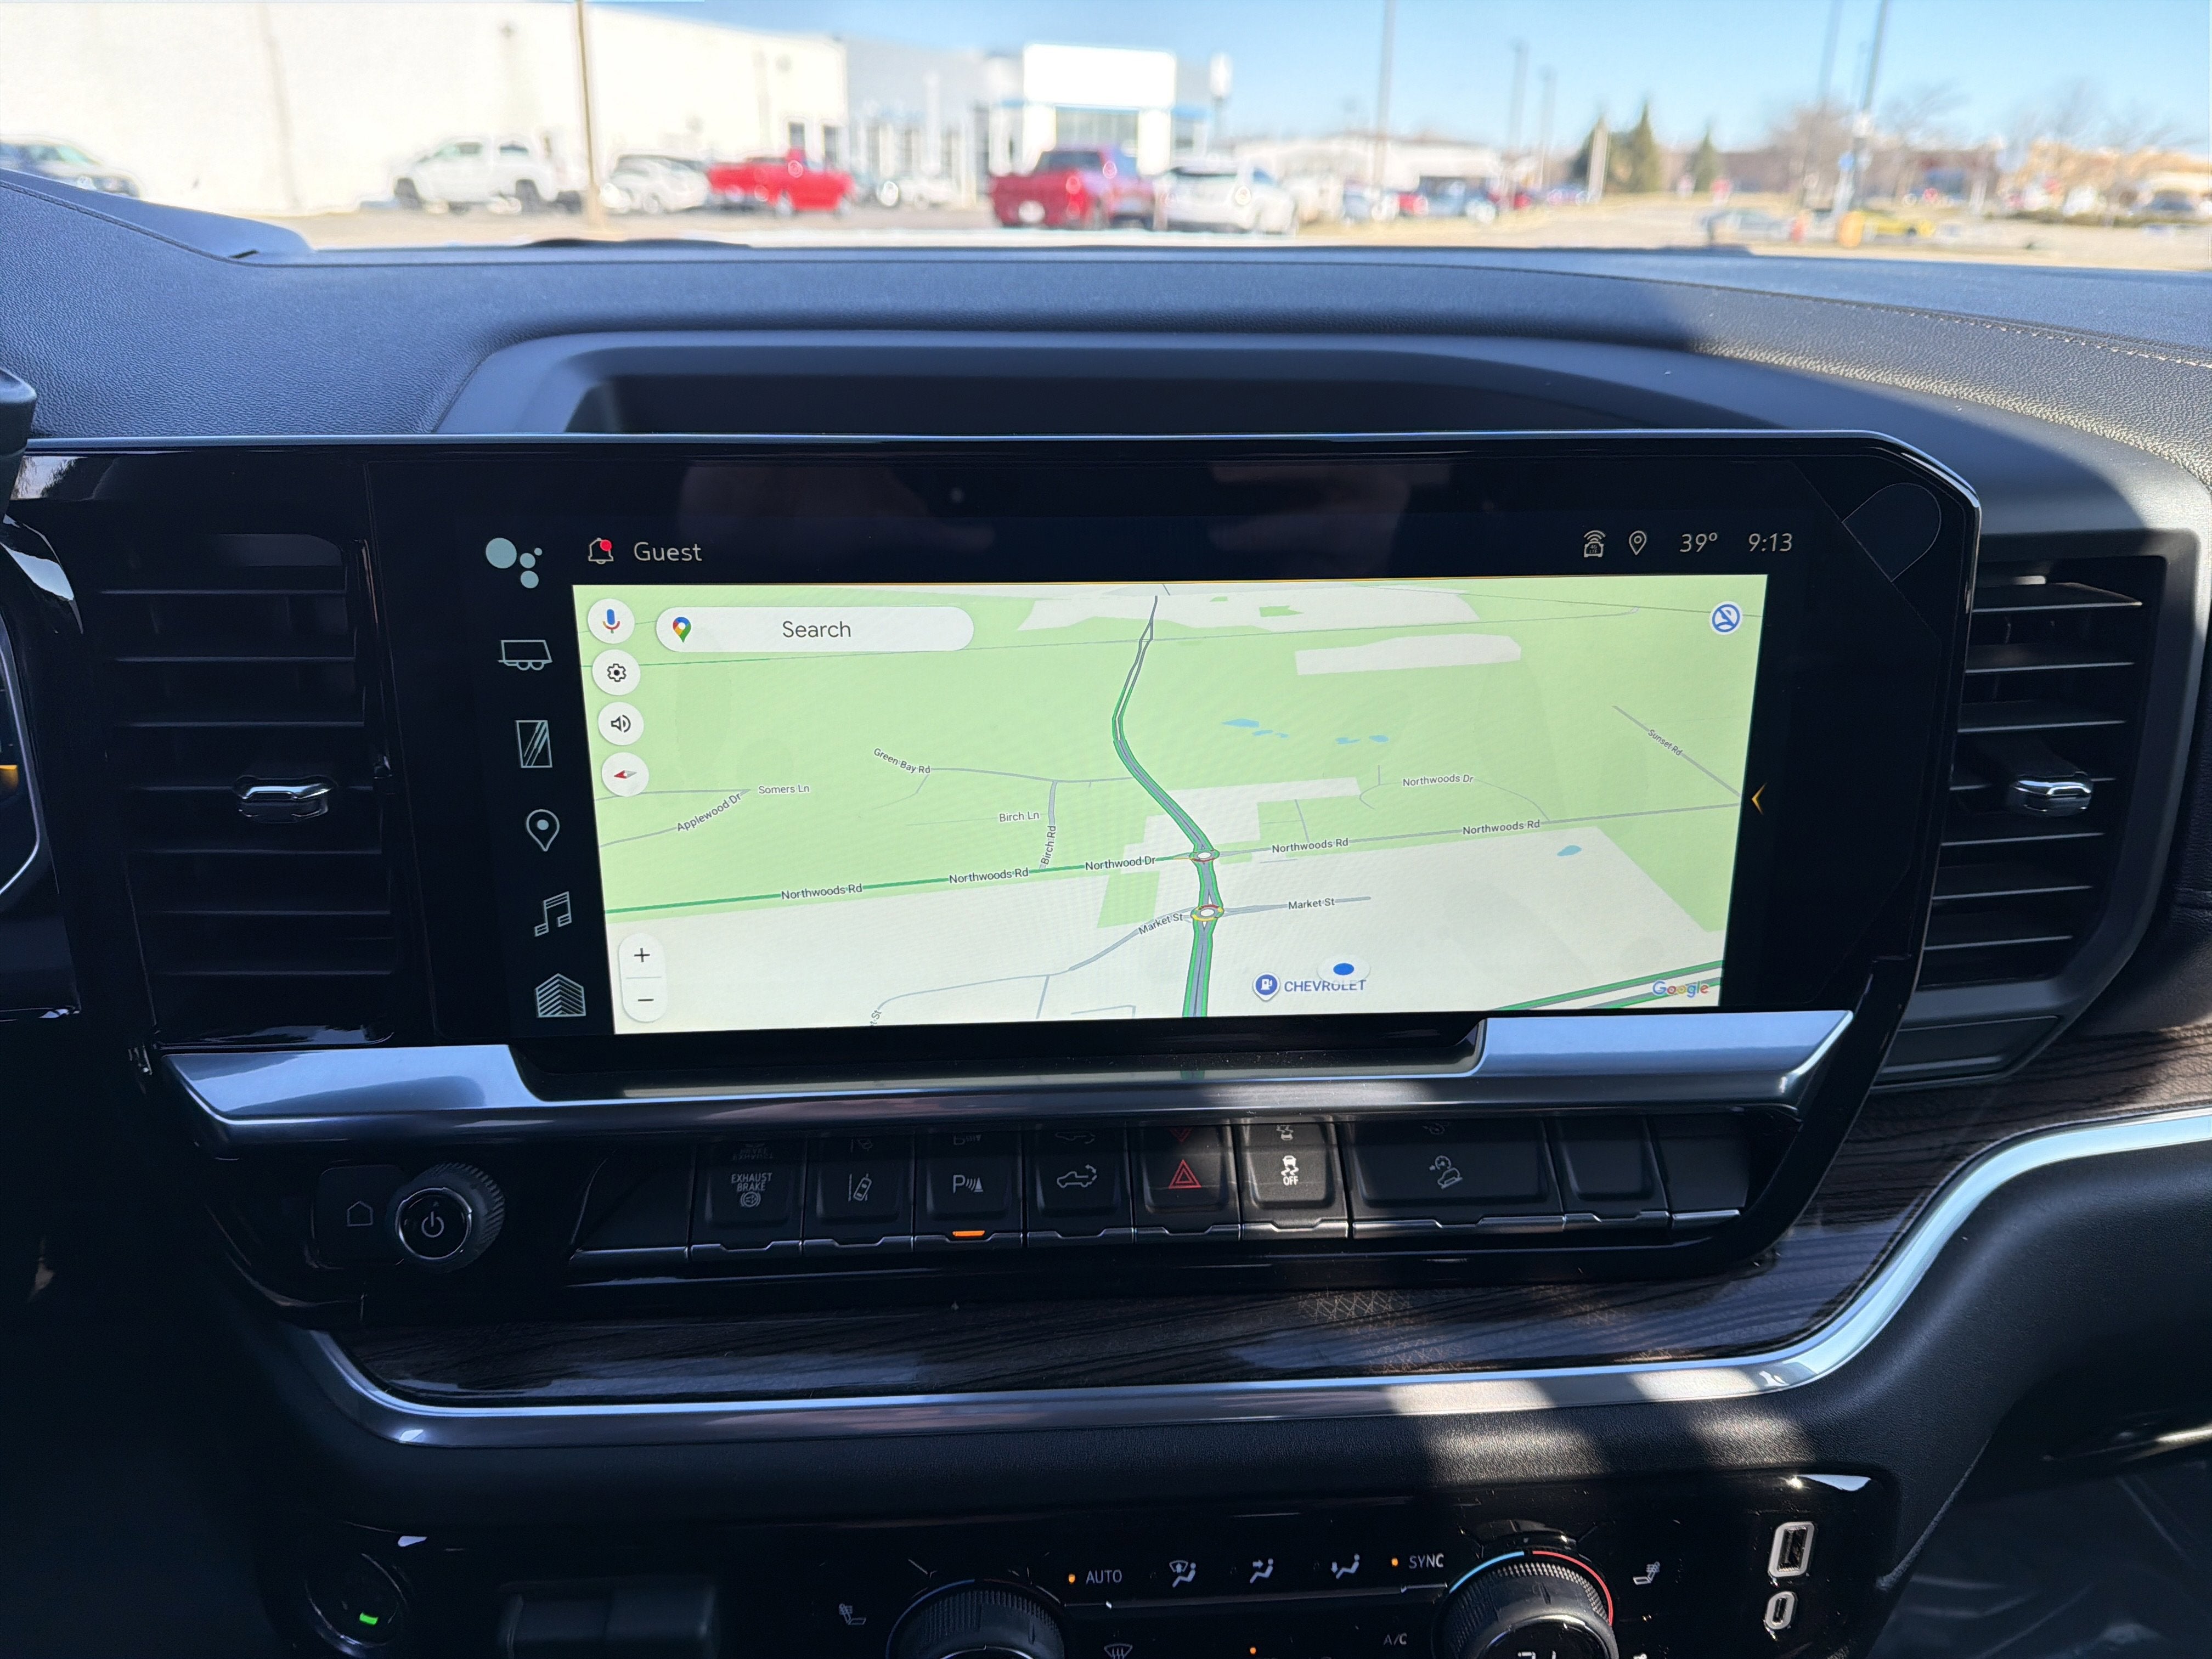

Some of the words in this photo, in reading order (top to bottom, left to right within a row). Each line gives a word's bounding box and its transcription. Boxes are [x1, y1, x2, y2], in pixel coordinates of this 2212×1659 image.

[1748, 533, 1793, 552] 9:13
[634, 541, 702, 562] Guest
[782, 621, 851, 639] Search
[1648, 729, 1672, 748] Sunset
[1672, 745, 1683, 756] Rd
[873, 748, 899, 764] Green
[899, 760, 917, 775] Bay
[918, 765, 931, 774] Rd
[758, 784, 795, 794] Somers
[798, 783, 810, 793] Ln
[1402, 774, 1461, 787] Northwoods
[1463, 774, 1474, 783] Dr
[676, 799, 731, 832] Applewood
[730, 792, 742, 805] Dr
[999, 812, 1024, 822] Birch
[1027, 811, 1040, 820] Ln
[1046, 825, 1057, 839] Rd
[1462, 822, 1525, 836] Northwoods
[1527, 820, 1541, 829] Rd
[1040, 840, 1054, 865] Birch
[1272, 839, 1333, 854] Northwoods
[1335, 838, 1348, 848] Rd
[1085, 858, 1143, 871] Northwood
[1144, 855, 1155, 865] Dr
[949, 870, 1012, 884] Northwoods
[1014, 867, 1029, 877] Rd
[781, 884, 846, 900] Northwoods
[848, 883, 863, 893] Rd
[1288, 899, 1322, 910] Market
[1323, 898, 1335, 907] St
[1138, 915, 1171, 935] Market
[1172, 912, 1183, 922] St
[1652, 980, 1709, 997] Google
[871, 1010, 882, 1019] St
[731, 1172, 772, 1183] EXHAUST
[1283, 1176, 1299, 1186] OFF
[737, 1182, 766, 1192] BRAKE
[1408, 1553, 1444, 1569] SYNC
[1086, 1568, 1122, 1584] AUTO
[1383, 1632, 1408, 1646] A/C
